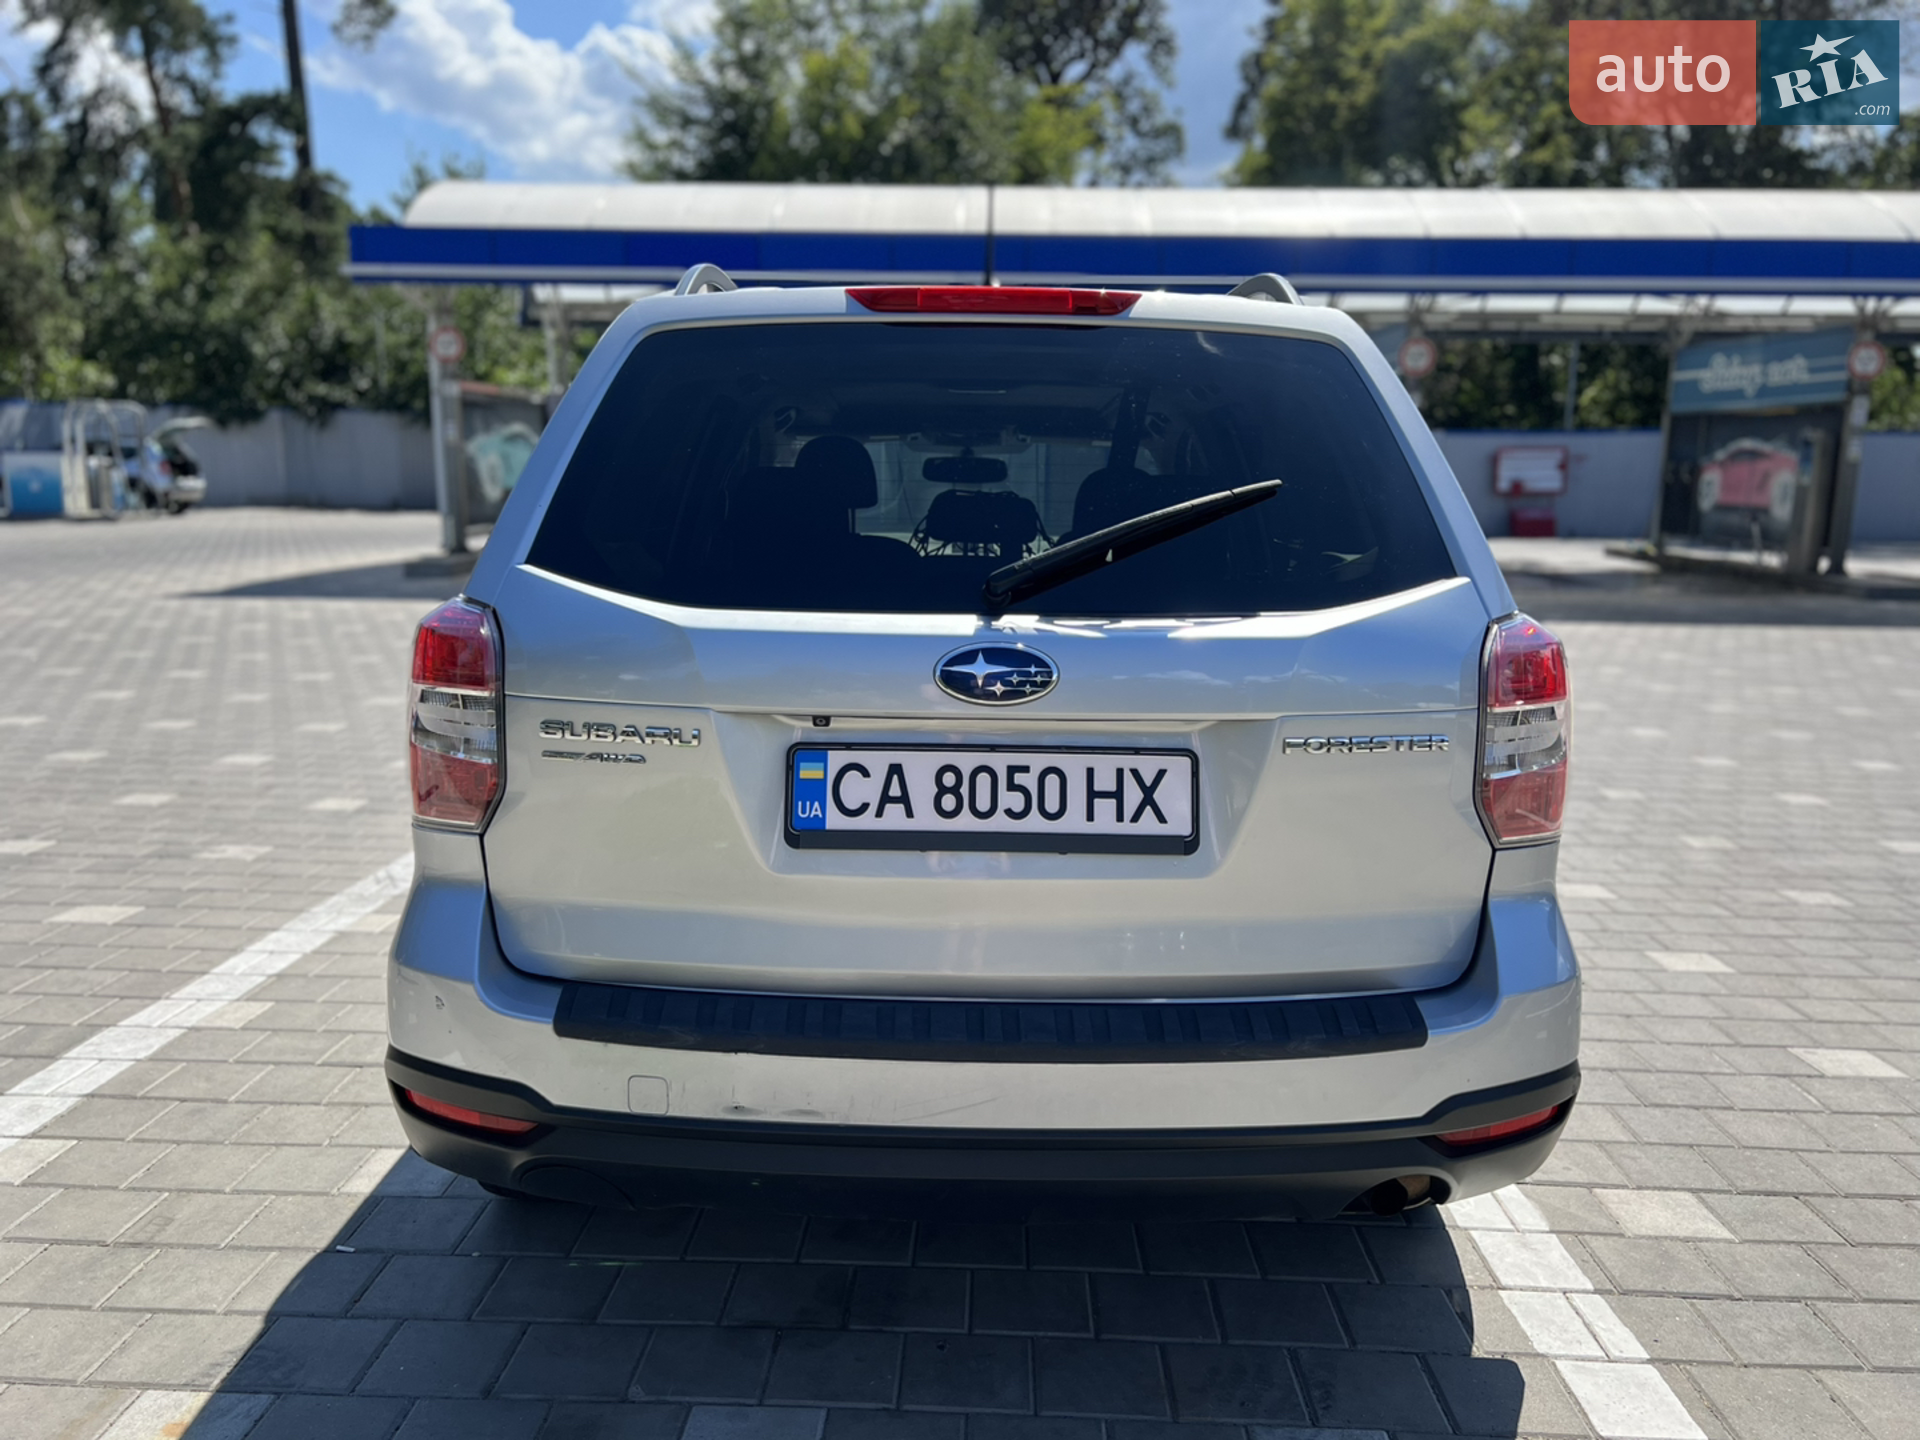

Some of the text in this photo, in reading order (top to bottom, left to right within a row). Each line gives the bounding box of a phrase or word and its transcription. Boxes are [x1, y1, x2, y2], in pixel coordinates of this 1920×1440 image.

[539, 719, 702, 748] SUBARU
[1282, 733, 1450, 755] FORESTER
[581, 751, 647, 764] AWD
[831, 762, 1168, 824] CA 8050 HX
[797, 800, 823, 818] UA
